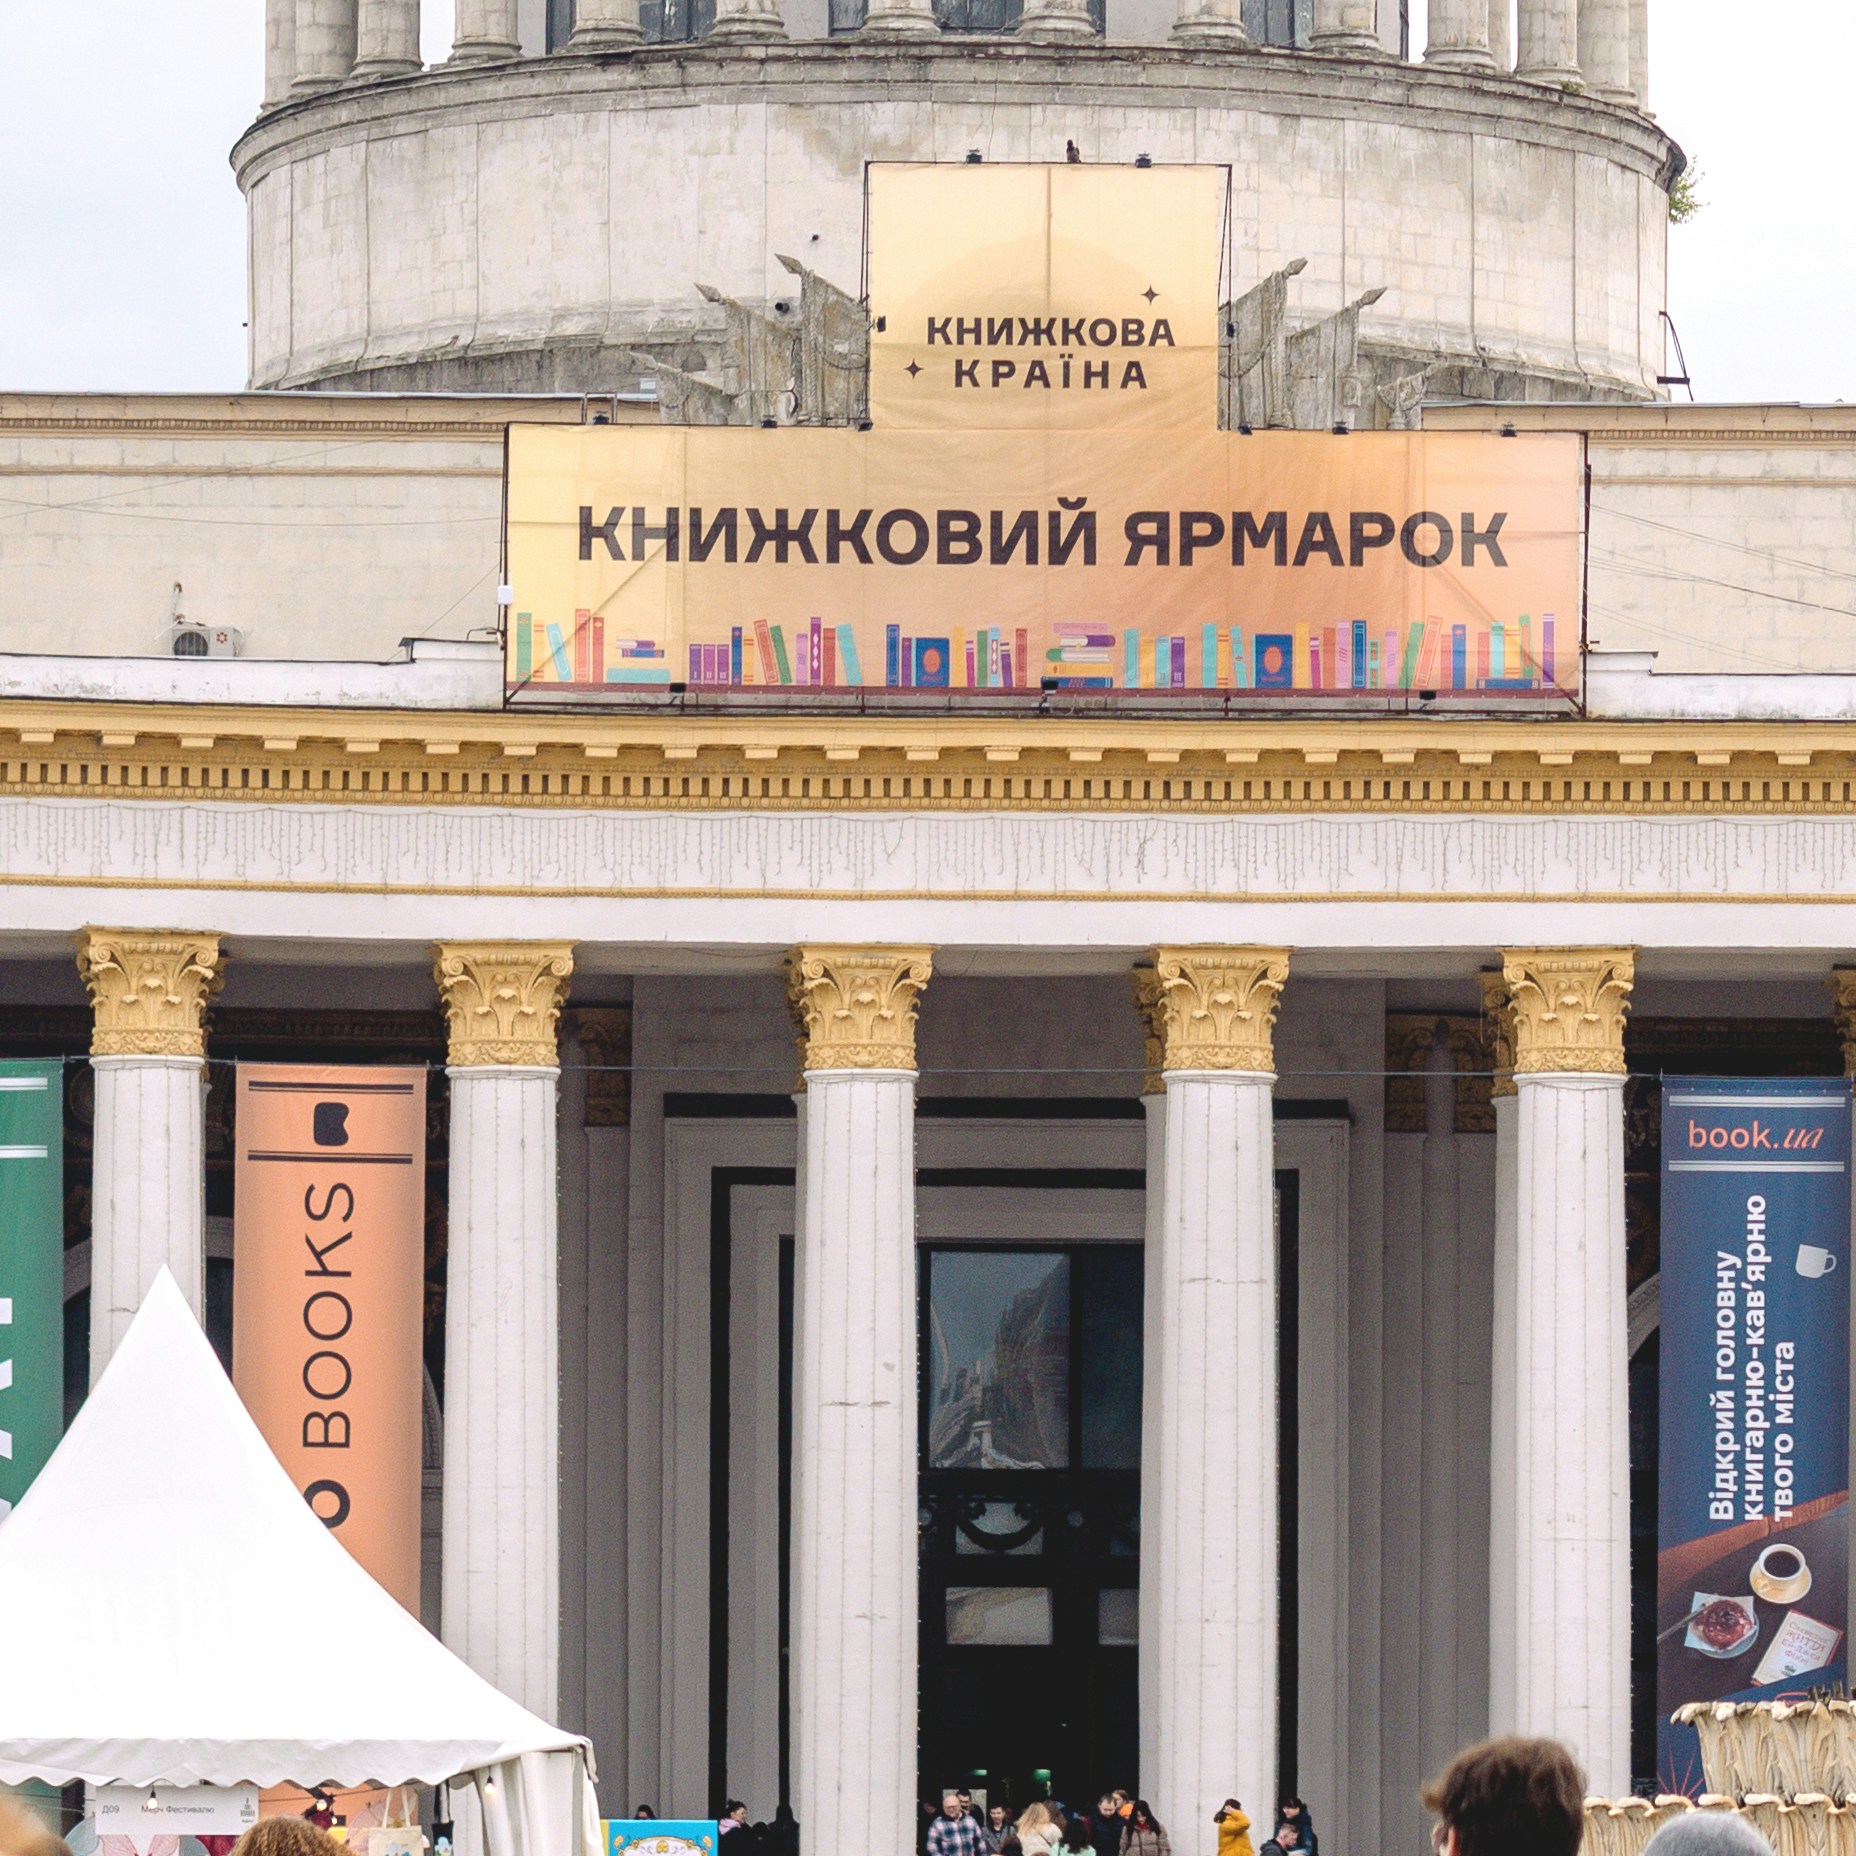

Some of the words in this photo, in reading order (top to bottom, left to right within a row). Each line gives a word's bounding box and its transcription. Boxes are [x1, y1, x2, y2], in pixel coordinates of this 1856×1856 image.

[926, 317, 1176, 348] КНИЖКОВА
[954, 356, 1148, 390] КРАЇНА
[576, 496, 1097, 567] КНИЖКОВИЙ
[1123, 511, 1509, 568] ЯРМАРОК
[1688, 1120, 1824, 1150] book.ua
[303, 1182, 355, 1449] BOOKS
[1716, 1251, 1742, 1381] головну
[1768, 1341, 1795, 1424] міста
[1709, 1390, 1742, 1521] Відкрий
[1774, 1433, 1795, 1521] твого
[102, 1805, 120, 1814] Д09
[166, 1805, 215, 1814] Фестивалю
